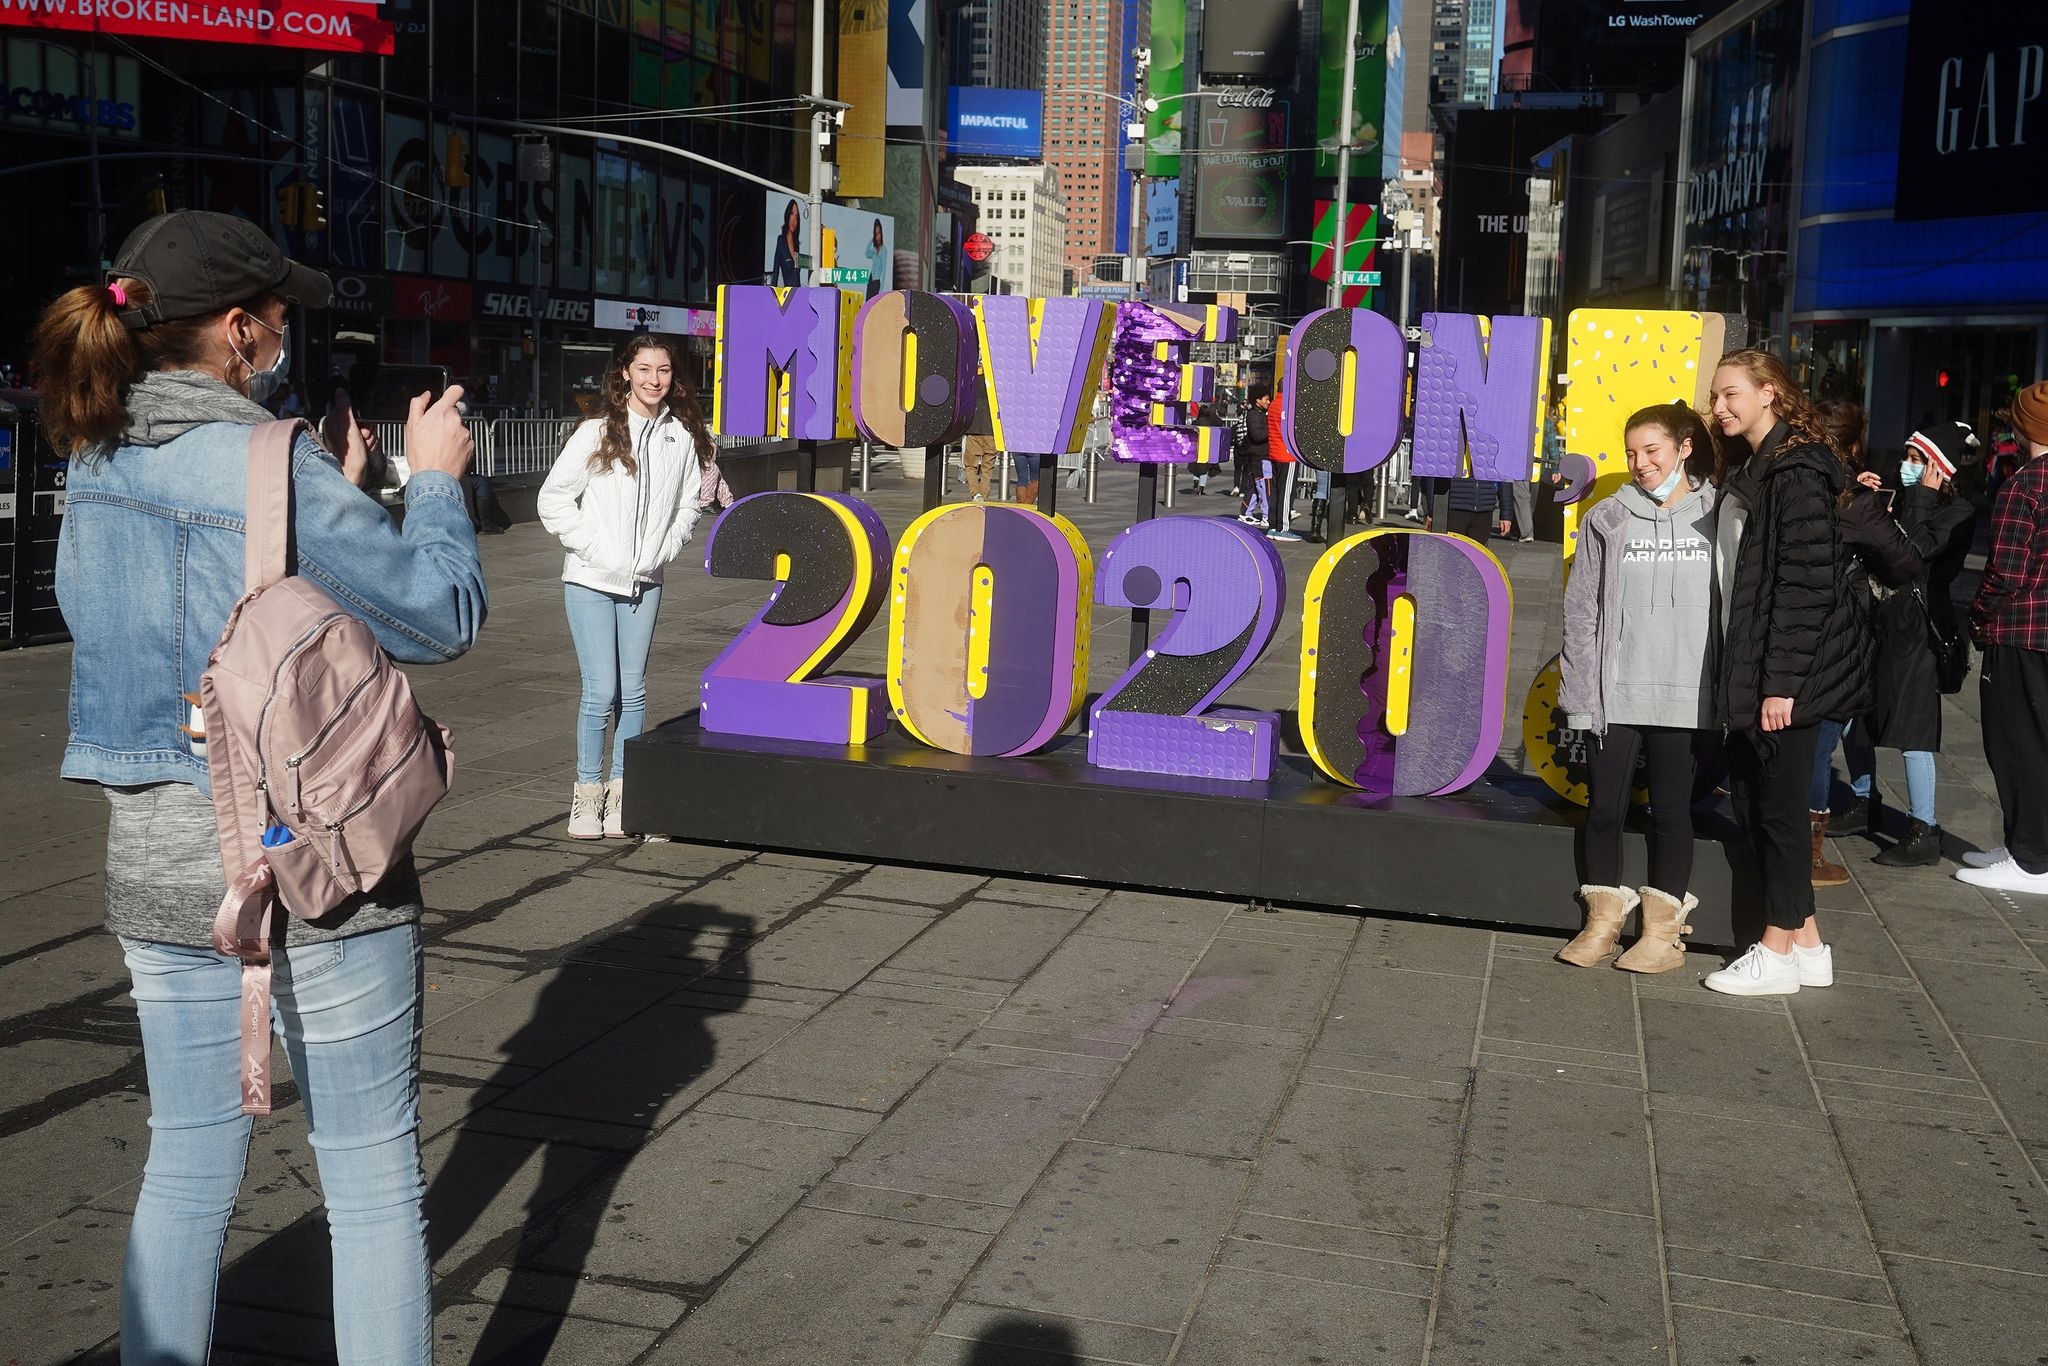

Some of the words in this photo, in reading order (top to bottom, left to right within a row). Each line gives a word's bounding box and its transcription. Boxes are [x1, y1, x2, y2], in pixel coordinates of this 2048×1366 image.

[1608, 15, 1626, 27] LG
[1217, 87, 1277, 109] Coca-Cola
[1935, 44, 2046, 155] GAP
[960, 114, 1029, 129] IMPACTFUL
[306, 106, 320, 180] NEWS
[1689, 169, 1718, 225] OLD
[1718, 148, 1768, 216] NAVY
[1477, 215, 1509, 233] THE
[833, 270, 842, 280] W
[845, 270, 857, 281] 44
[1356, 273, 1370, 284] 44
[714, 285, 1239, 465] MOVE
[1630, 537, 1700, 550] UNDER
[1622, 550, 1709, 563] ARMOUR
[699, 489, 1515, 800] 2020
[251, 1003, 259, 1038] SPORT
[247, 1052, 264, 1102] AK
